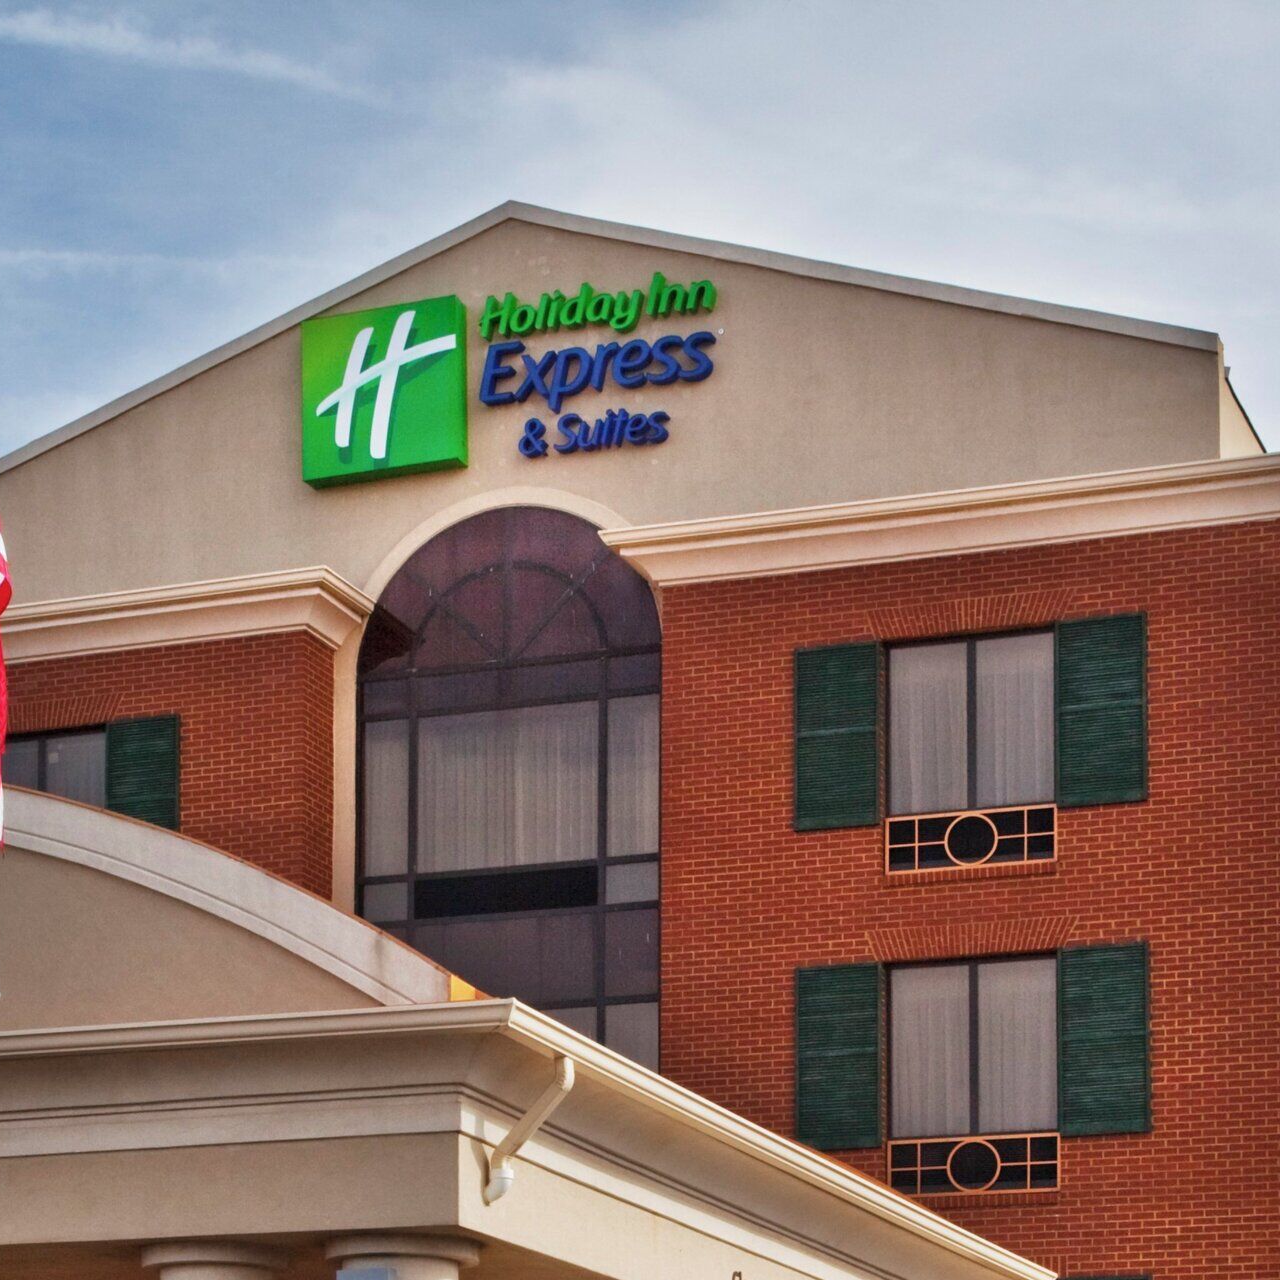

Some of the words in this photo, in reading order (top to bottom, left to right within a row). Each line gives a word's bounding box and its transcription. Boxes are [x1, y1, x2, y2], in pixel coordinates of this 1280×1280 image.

[478, 282, 641, 341] Holiday
[646, 272, 717, 316] Inn
[479, 331, 717, 414] Express
[518, 417, 549, 459] &
[553, 408, 671, 454] Suites
